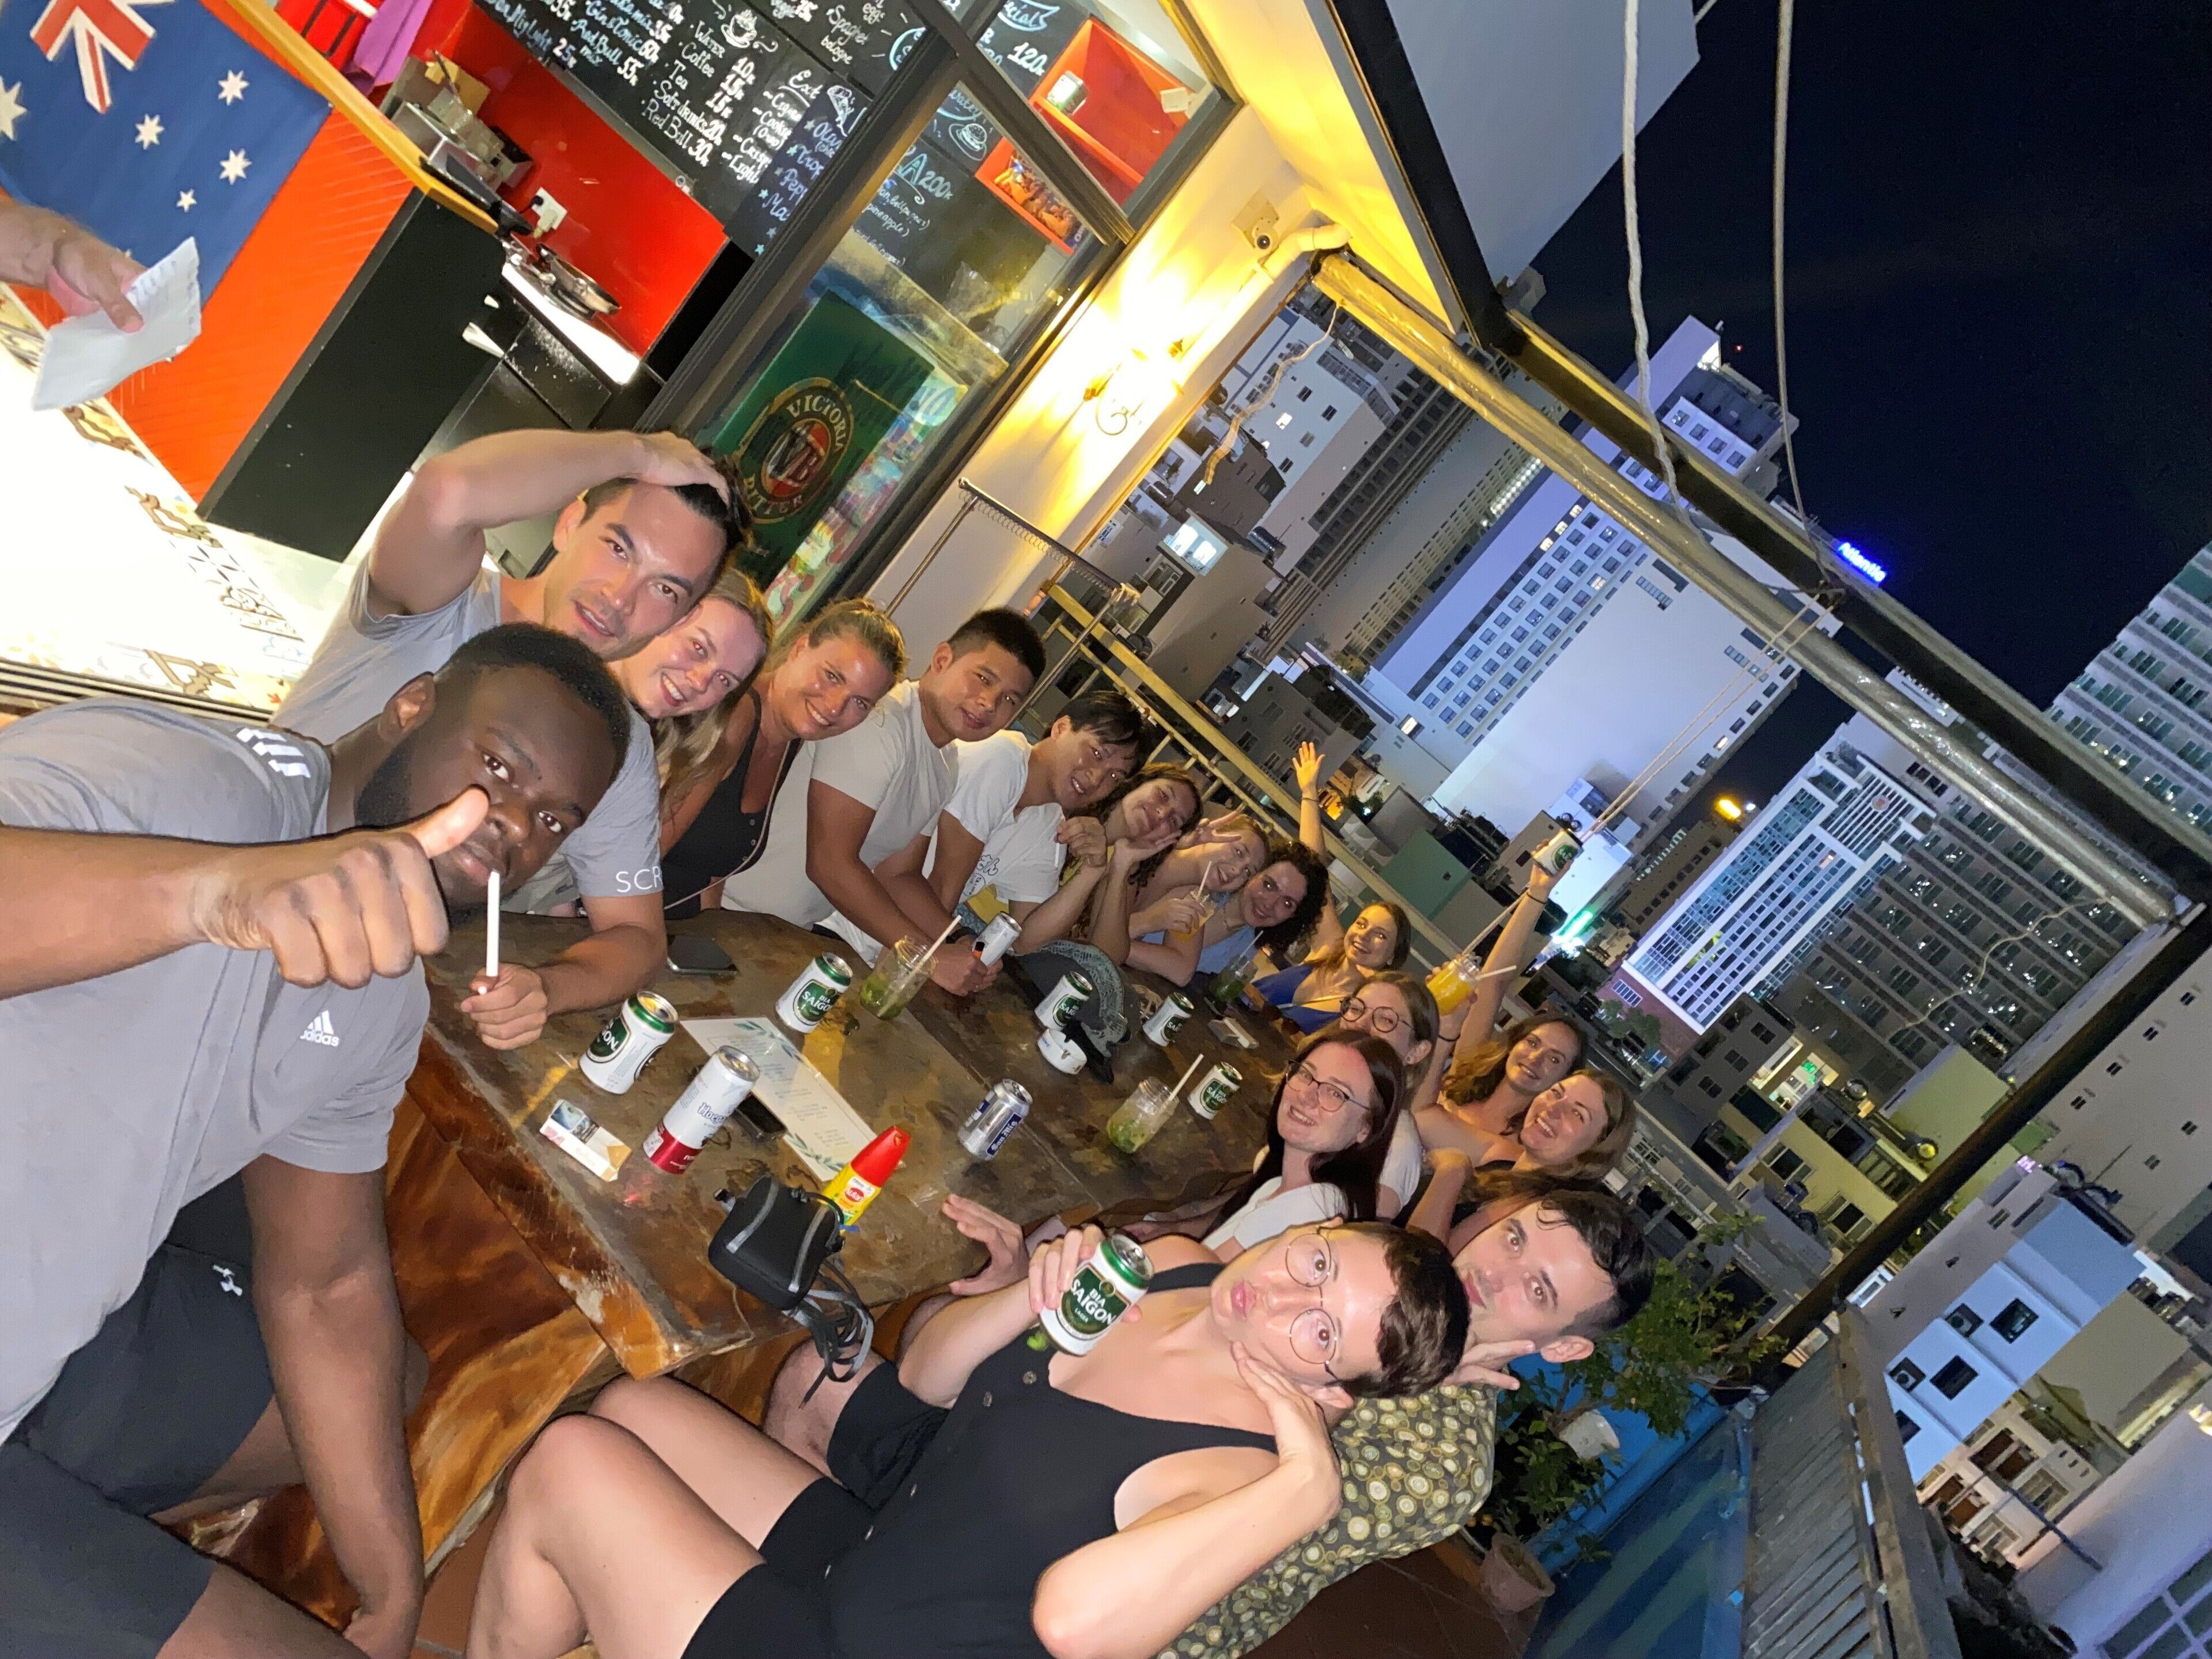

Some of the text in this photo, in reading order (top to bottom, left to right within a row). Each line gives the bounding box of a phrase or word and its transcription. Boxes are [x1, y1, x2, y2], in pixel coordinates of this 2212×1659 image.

[681, 41, 745, 101] Coffee 15k
[732, 56, 756, 85] 10k
[1006, 41, 1047, 77] 120k
[668, 59, 733, 119] Tea 15k
[641, 97, 714, 167] Red Bull 30k
[702, 119, 727, 146] 20k
[919, 171, 955, 200] 200k
[786, 394, 847, 454] VICTORIA
[615, 866, 664, 893] SCR
[819, 995, 831, 1005] BIA
[1070, 1278, 1117, 1325] SAIGON
[1089, 1287, 1106, 1308] BIA
